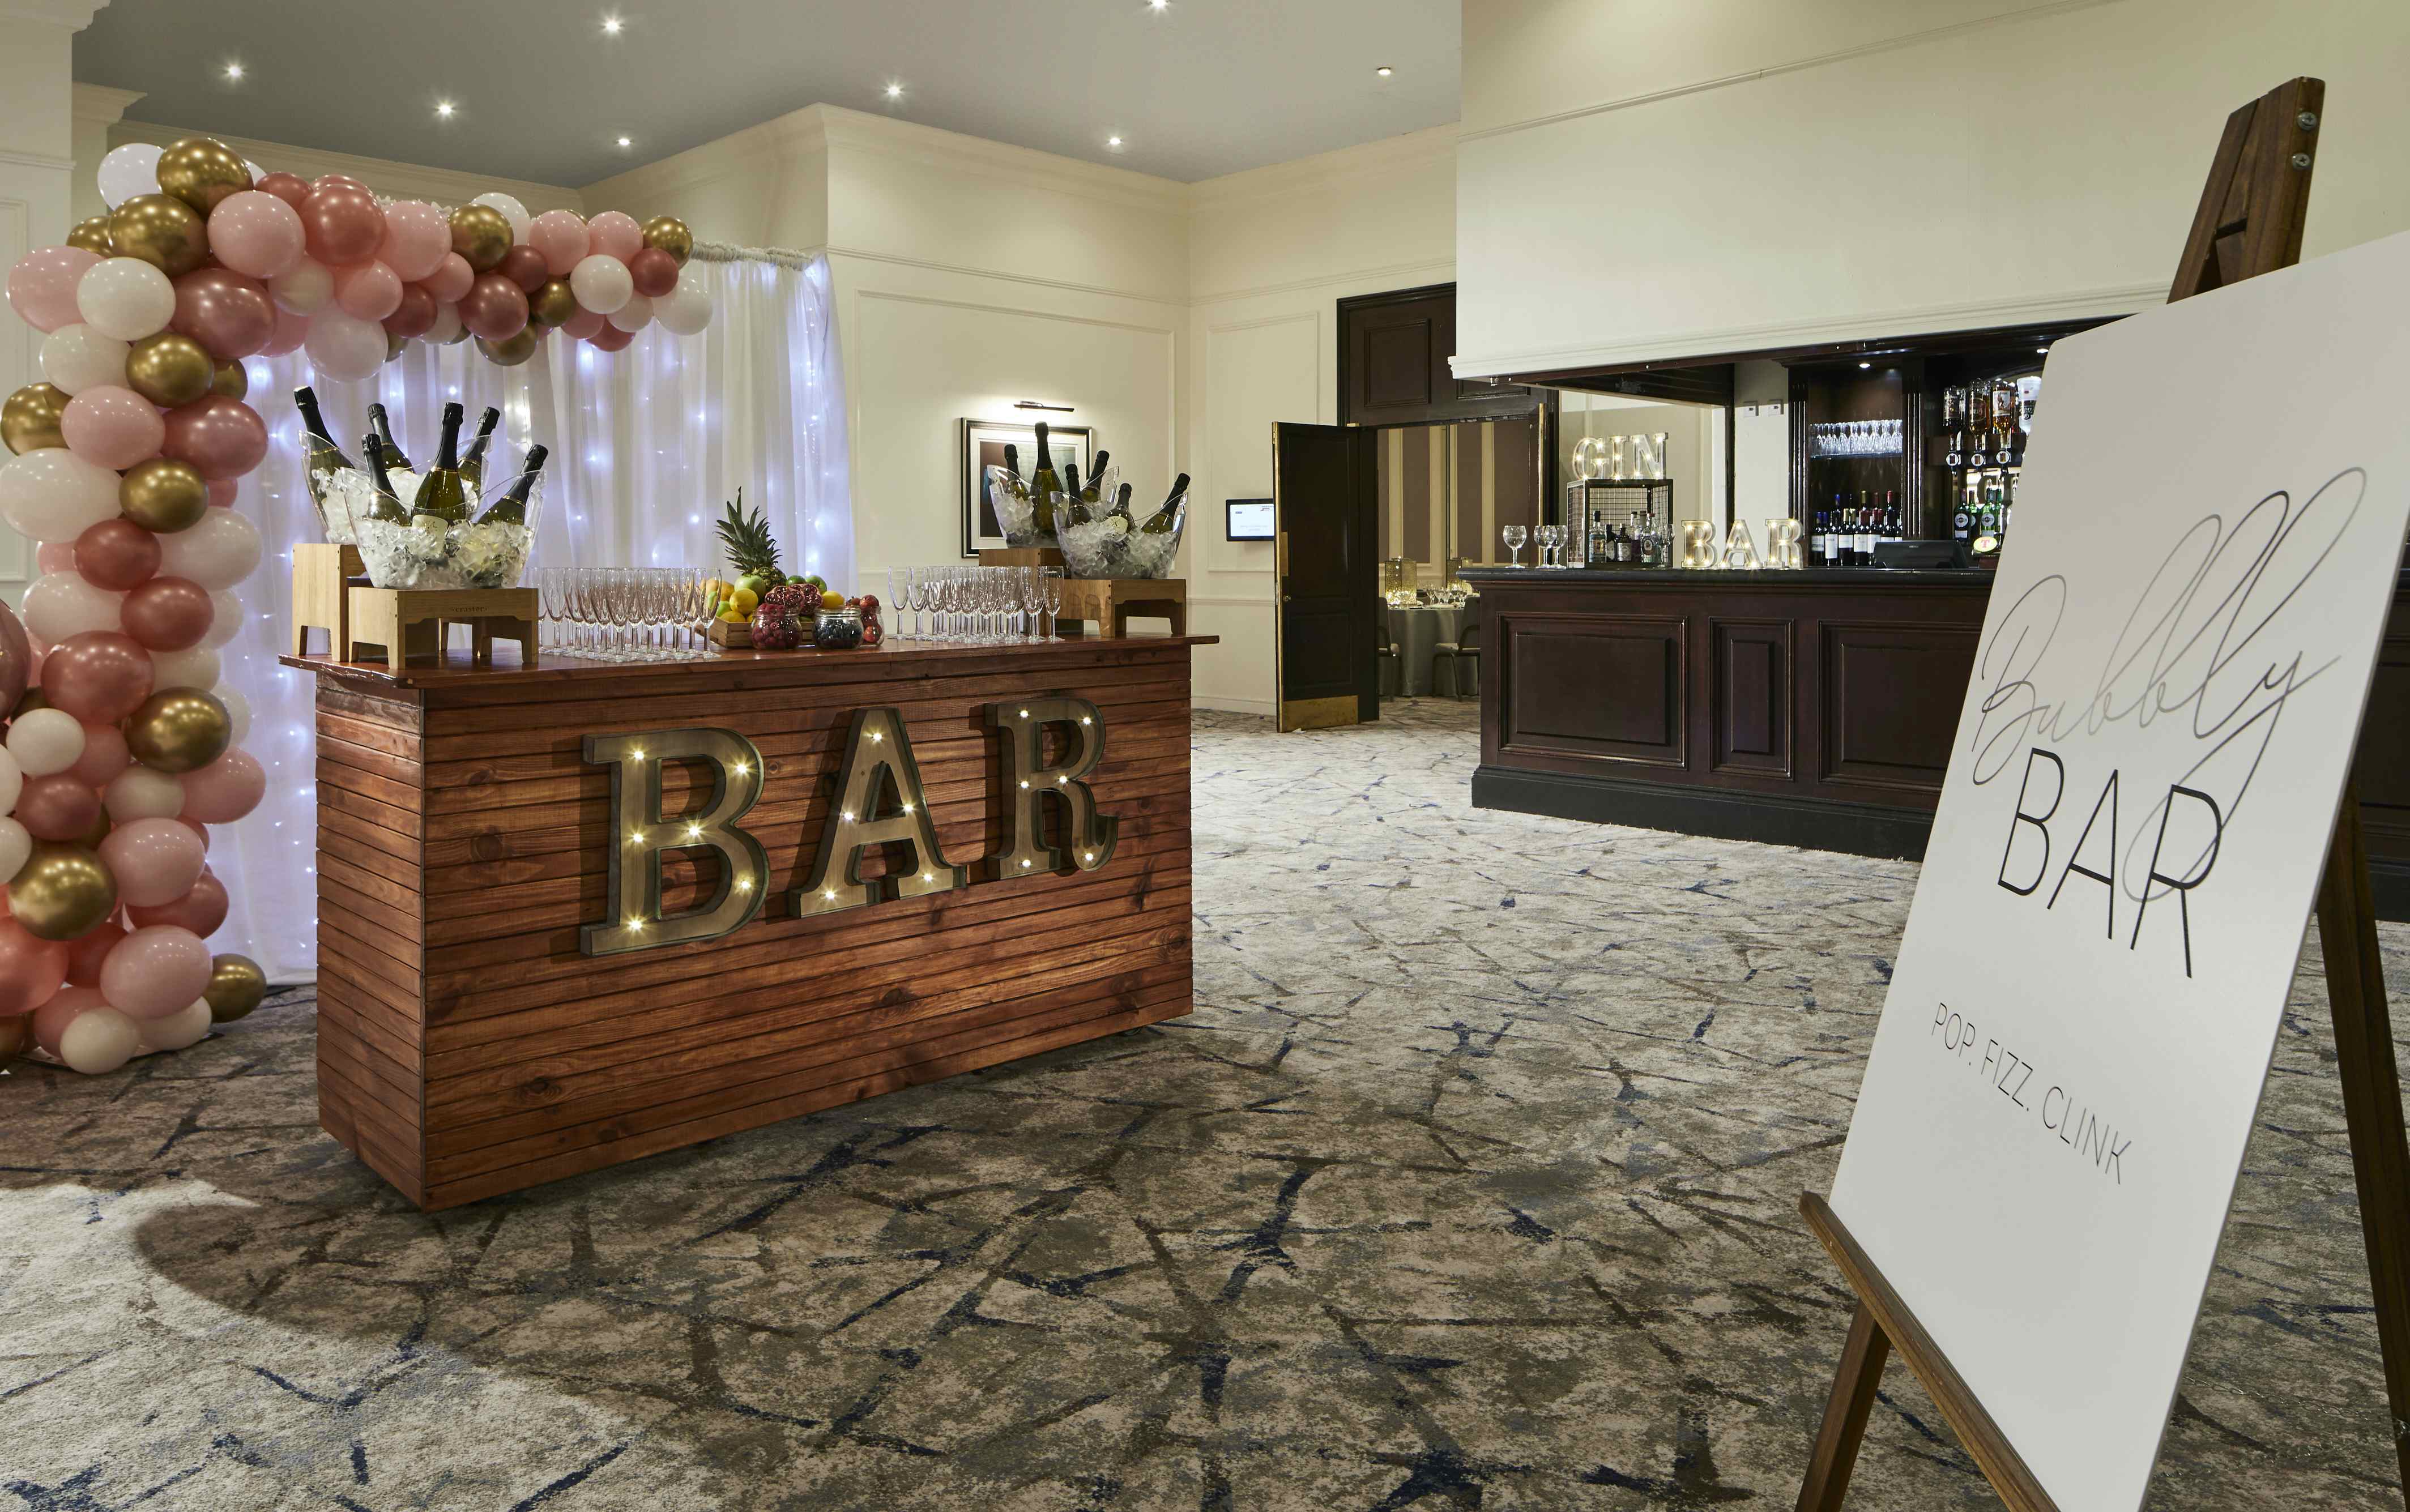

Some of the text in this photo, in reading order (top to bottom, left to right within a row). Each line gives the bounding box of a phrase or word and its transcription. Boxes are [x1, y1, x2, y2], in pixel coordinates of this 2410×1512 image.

[1573, 432, 1669, 480] GIN
[1682, 518, 1805, 569] BAR
[1972, 467, 2367, 903] Bubbly
[580, 697, 1118, 956] BAR
[1998, 747, 2223, 979] BAR
[1931, 1002, 2132, 1185] POP. FIZZ. CLINK
